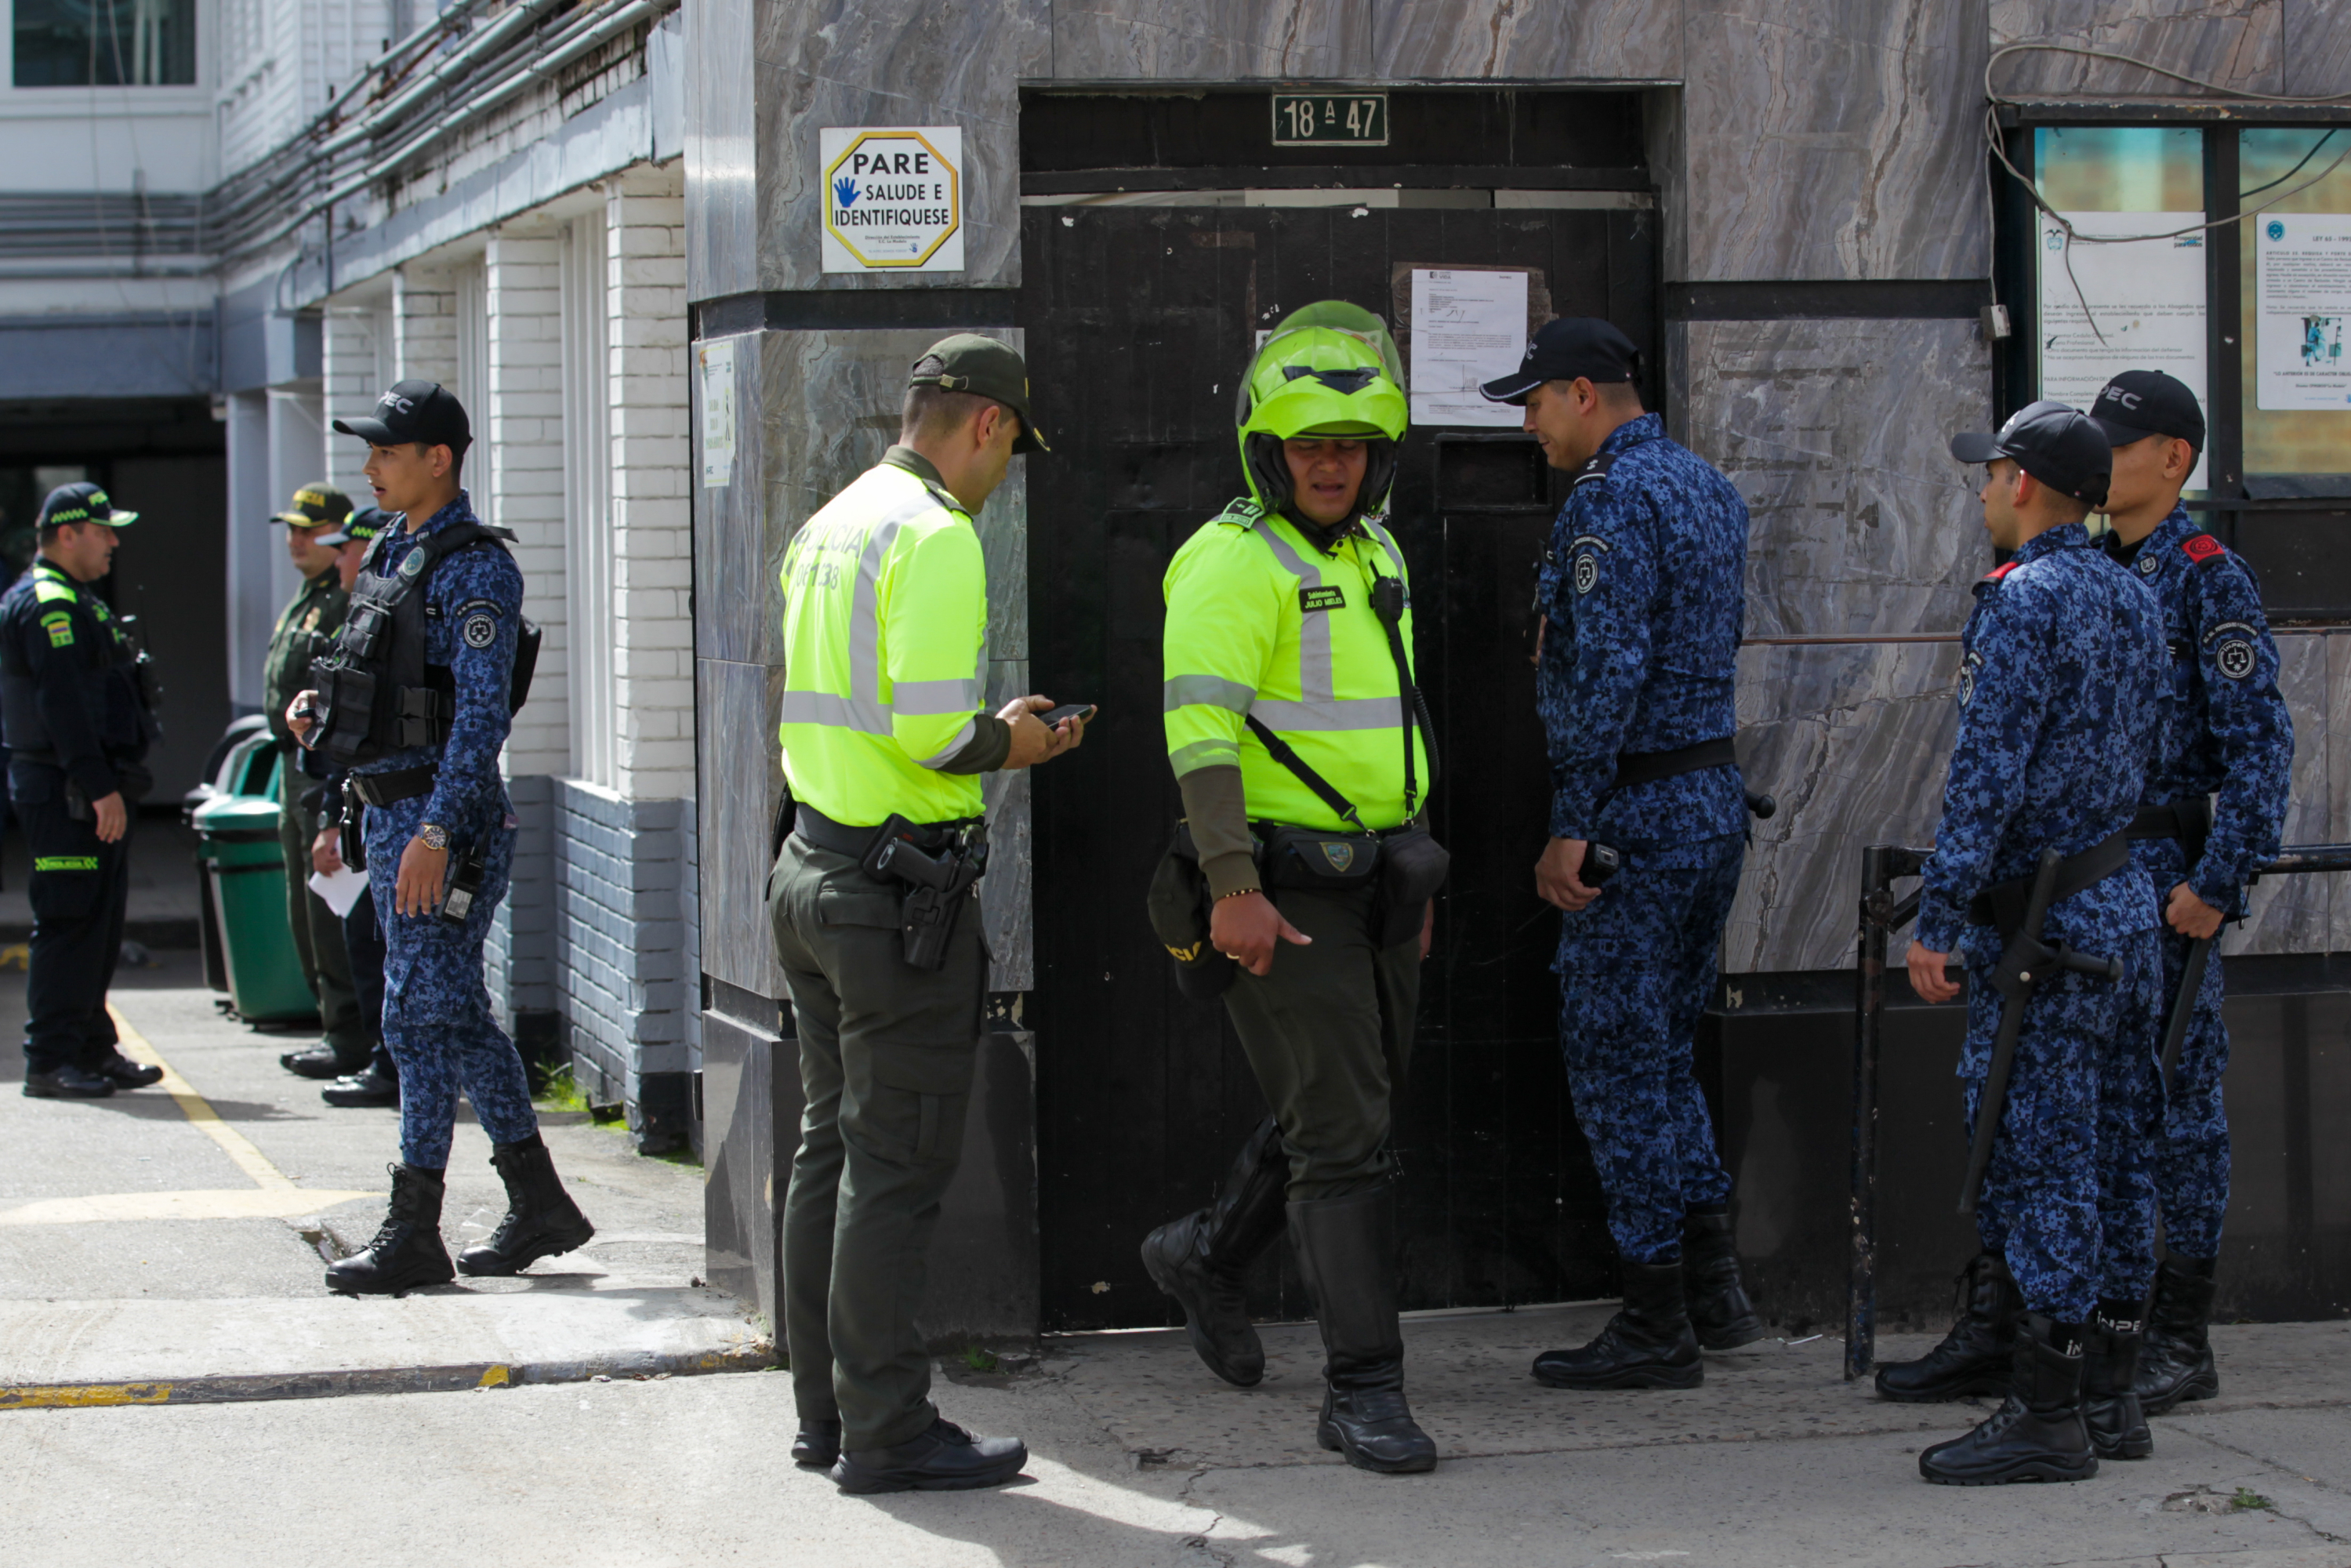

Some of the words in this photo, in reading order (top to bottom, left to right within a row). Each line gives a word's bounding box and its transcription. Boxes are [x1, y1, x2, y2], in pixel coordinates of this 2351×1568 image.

[1284, 100, 1314, 138] 18
[1325, 100, 1335, 118] A
[1346, 100, 1377, 137] 47
[854, 153, 928, 174] PARE
[865, 184, 925, 201] SALUDE
[934, 184, 941, 200] E
[835, 209, 949, 226] IDENTIFIQUESE
[378, 391, 414, 414] PEC
[2099, 385, 2142, 410] PEC
[1305, 600, 1322, 608] JULIO
